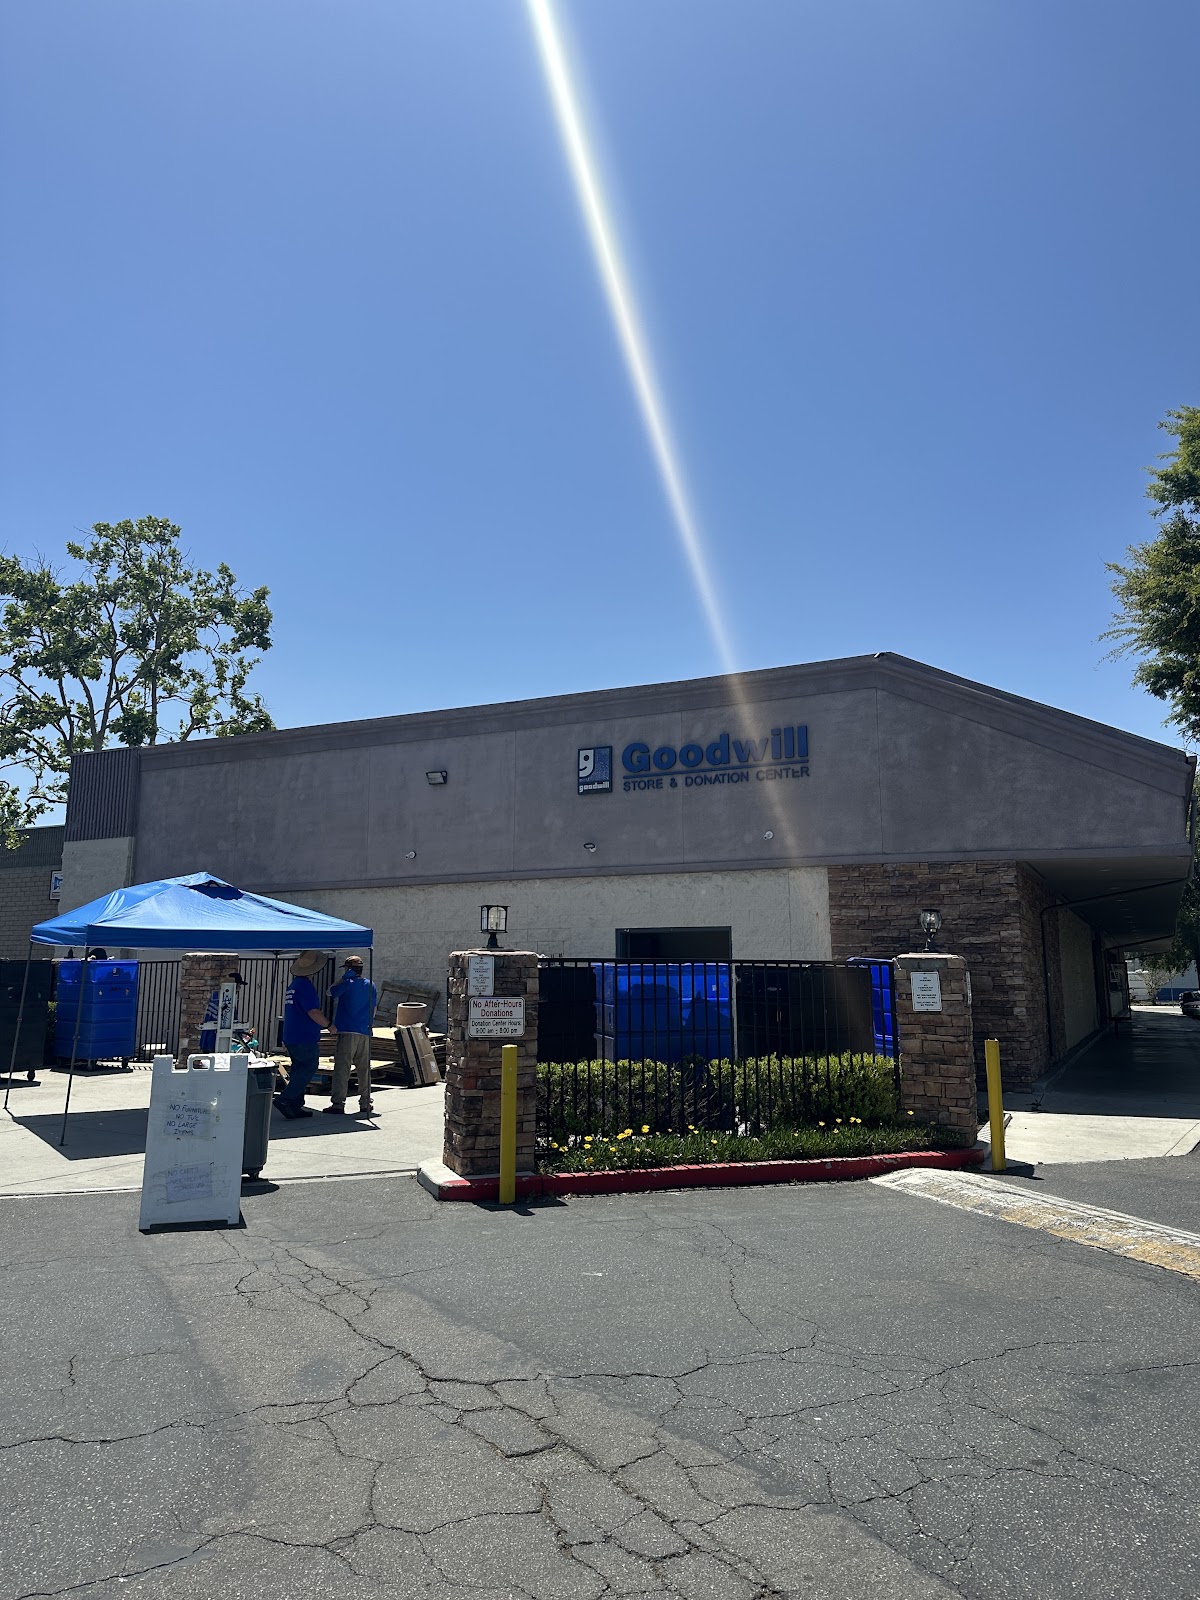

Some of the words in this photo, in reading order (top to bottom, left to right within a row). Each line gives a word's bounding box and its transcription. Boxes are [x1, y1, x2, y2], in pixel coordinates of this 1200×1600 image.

[621, 725, 809, 773] Goodwill
[623, 778, 664, 792] STORE
[669, 779, 678, 788] &
[685, 771, 750, 787] DONATION
[755, 766, 810, 781] CENTER
[579, 781, 610, 793] goodwill
[473, 1000, 482, 1008] No
[485, 1000, 522, 1008] After-Hours
[481, 1009, 513, 1017] Donations
[178, 1121, 197, 1129] LARGE
